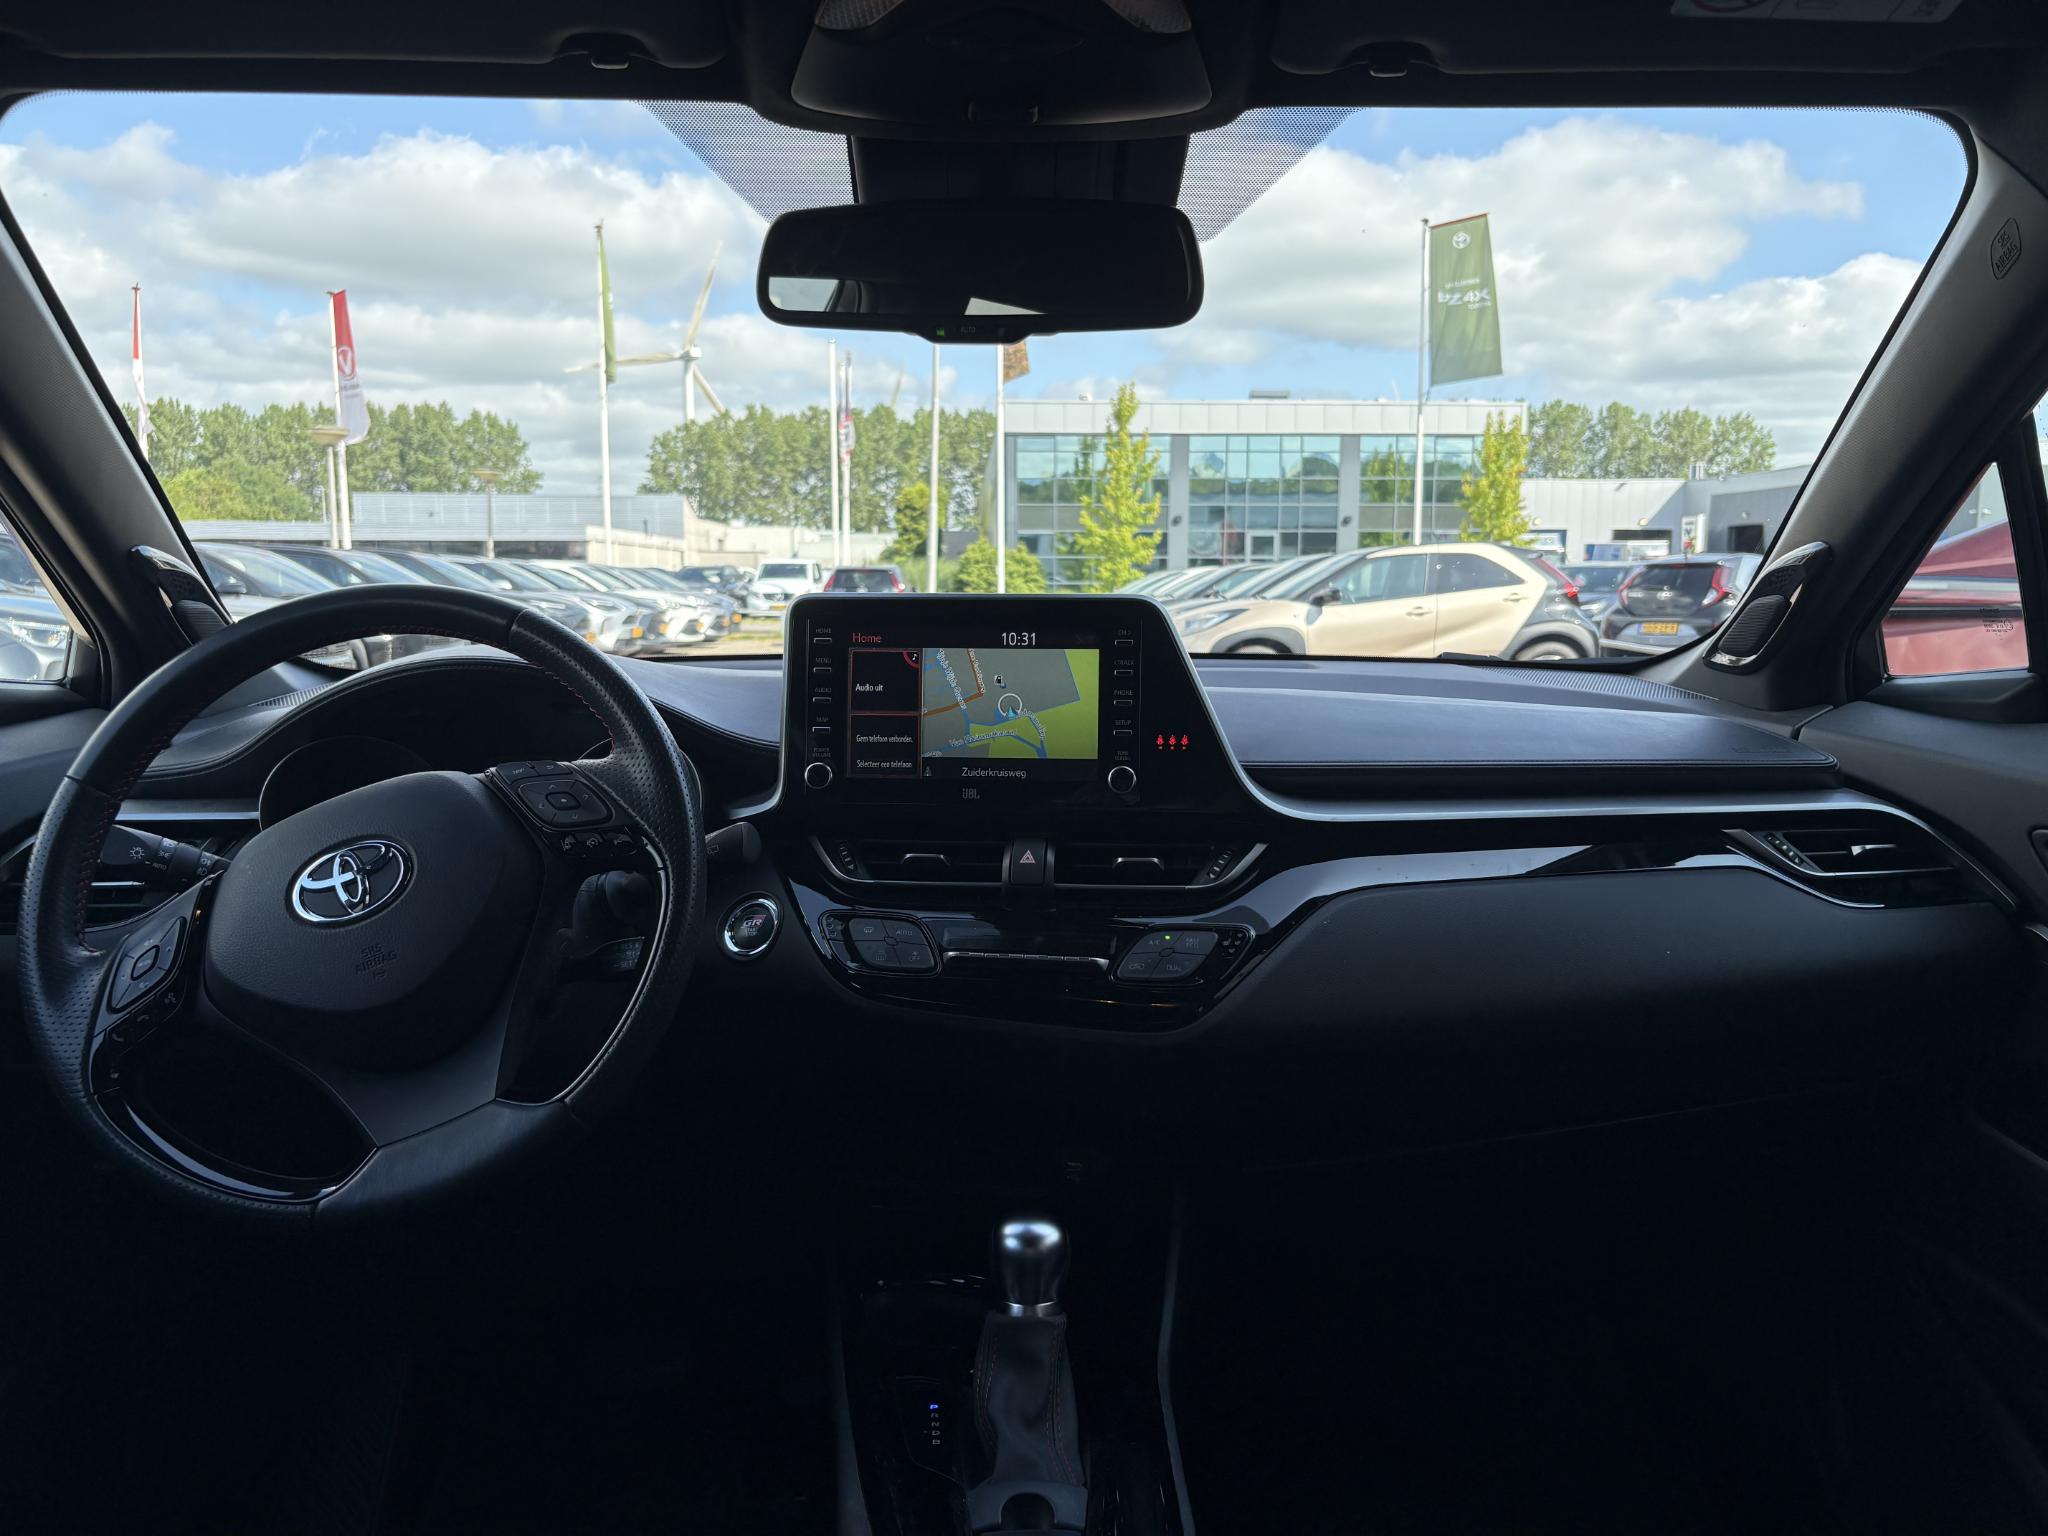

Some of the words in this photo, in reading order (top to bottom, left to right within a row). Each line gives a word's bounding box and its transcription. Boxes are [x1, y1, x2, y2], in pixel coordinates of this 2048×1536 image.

[1995, 241, 2018, 271] AIRBAG
[852, 632, 882, 644] Home
[1000, 632, 1037, 646] 10:31
[856, 684, 873, 692] Audio
[874, 684, 884, 692] uit
[856, 735, 869, 743] Geen
[869, 735, 888, 743] telefoon
[856, 760, 880, 768] Selecteer
[891, 760, 912, 768] telefoon
[961, 767, 1027, 780] Zuiderkruisweg
[962, 788, 981, 800] JBL
[743, 918, 763, 927] GR
[361, 944, 383, 958] SRS
[355, 950, 398, 975] AIRBAG
